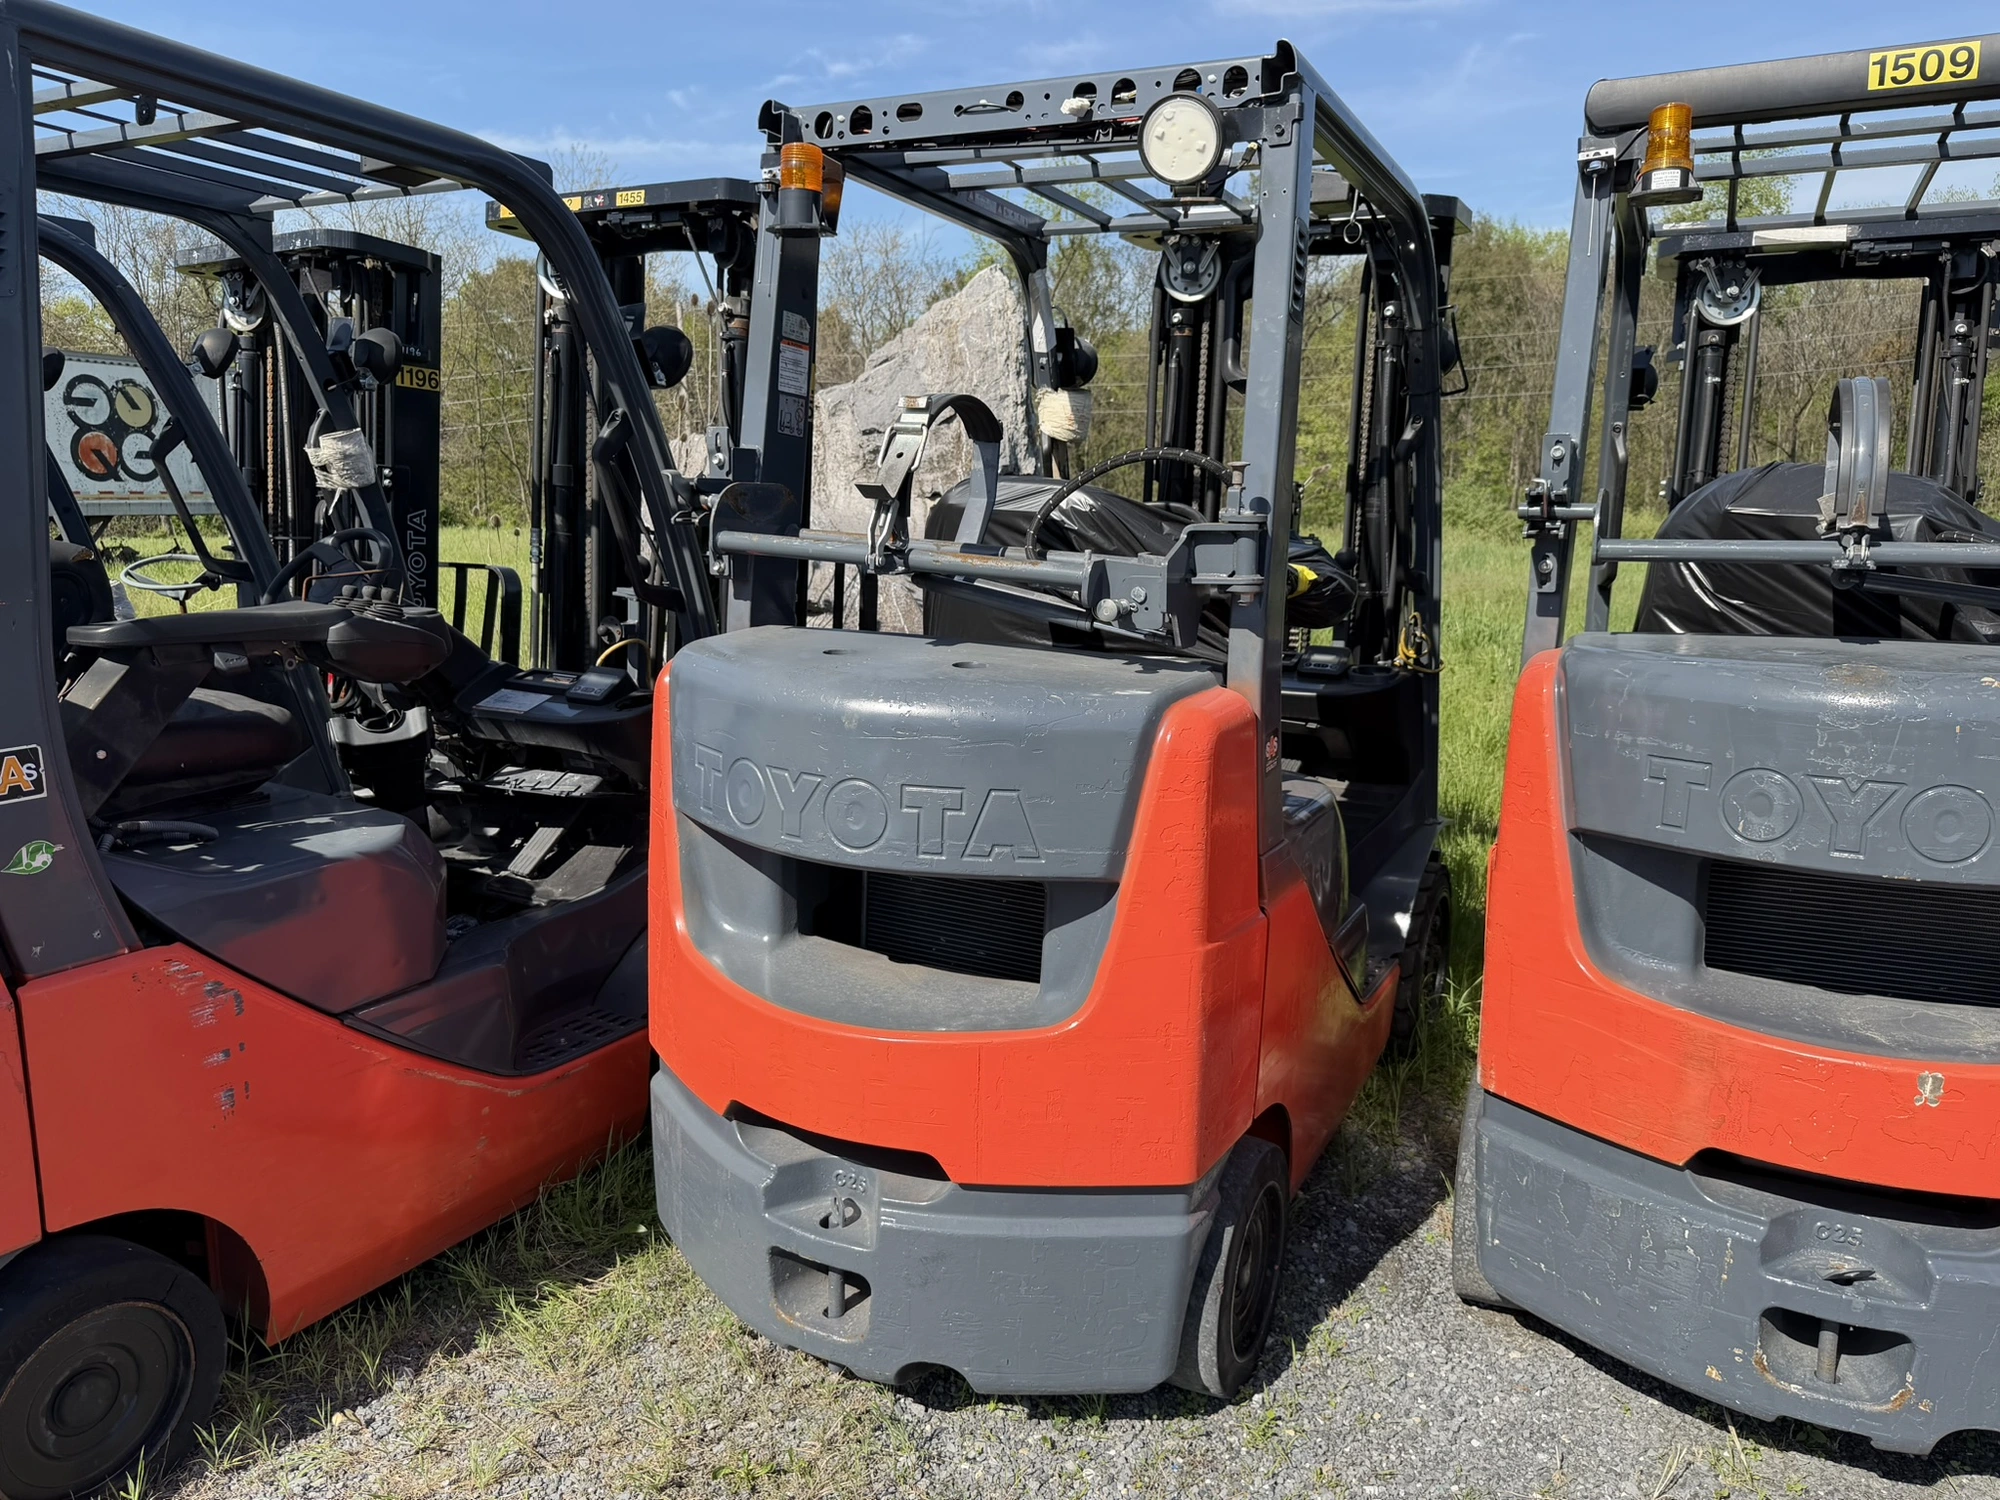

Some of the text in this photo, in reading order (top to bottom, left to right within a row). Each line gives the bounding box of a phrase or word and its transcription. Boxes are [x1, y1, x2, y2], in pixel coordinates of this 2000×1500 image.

[1871, 45, 1975, 87] 1509
[618, 191, 643, 204] 1455
[400, 366, 439, 390] 1196
[407, 509, 427, 607] OYOTA
[0, 755, 38, 795] AS
[695, 742, 1045, 863] TOYOTA
[1644, 754, 1996, 868] TOYO
[1813, 1221, 1864, 1249] C25
